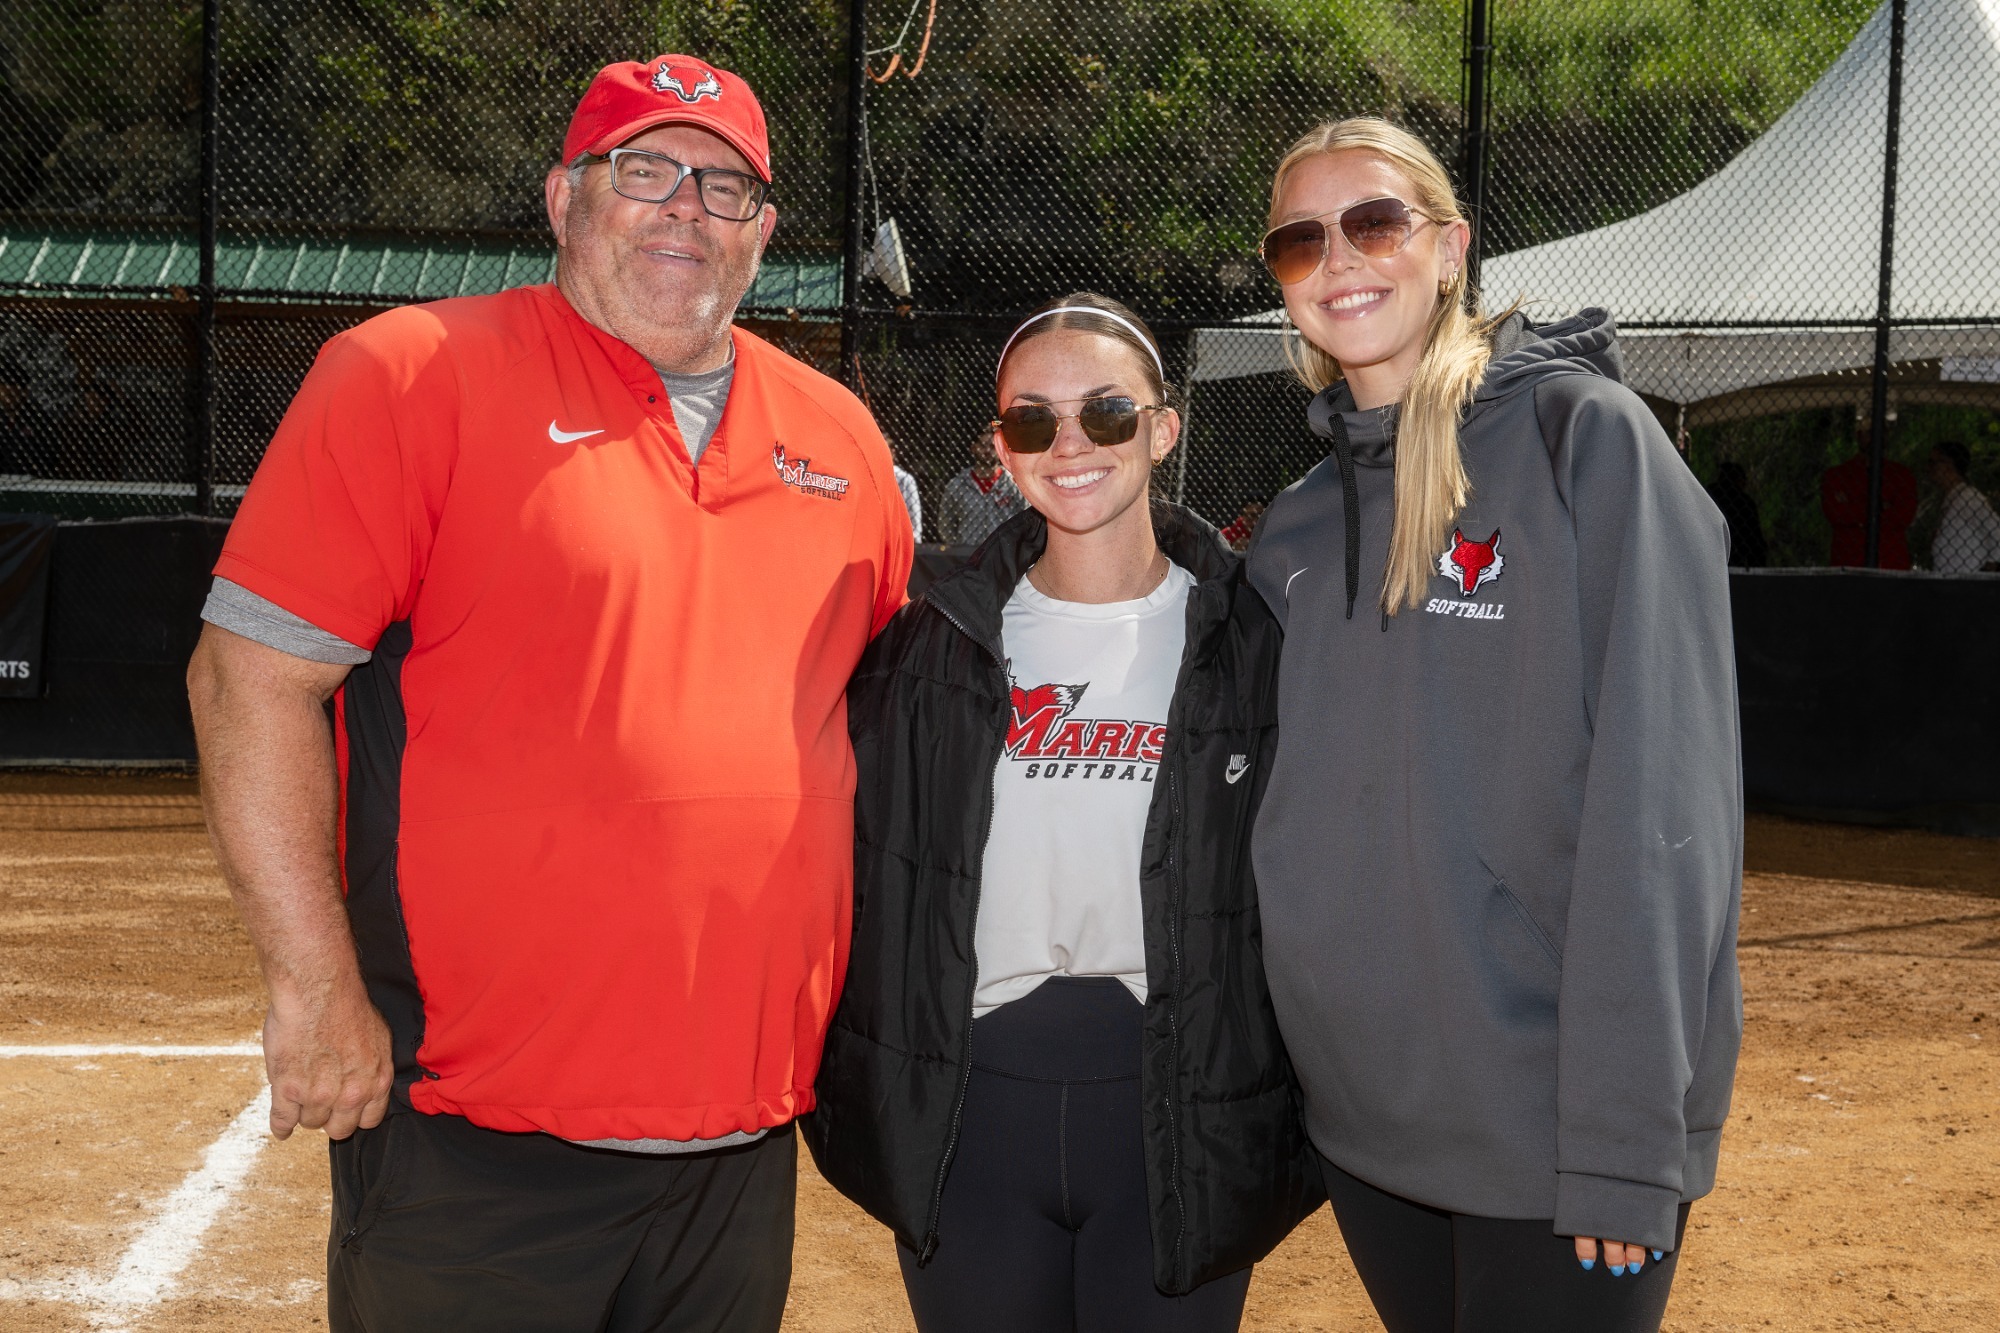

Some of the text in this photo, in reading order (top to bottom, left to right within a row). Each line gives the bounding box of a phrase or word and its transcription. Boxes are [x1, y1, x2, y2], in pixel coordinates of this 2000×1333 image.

[783, 465, 849, 494] MARIST
[801, 487, 841, 501] SOFTBALL
[1425, 598, 1504, 619] SOFTBALL
[0, 660, 30, 679] RTS
[1228, 754, 1247, 770] NIKE
[1025, 763, 1153, 782] SOFTBAL
